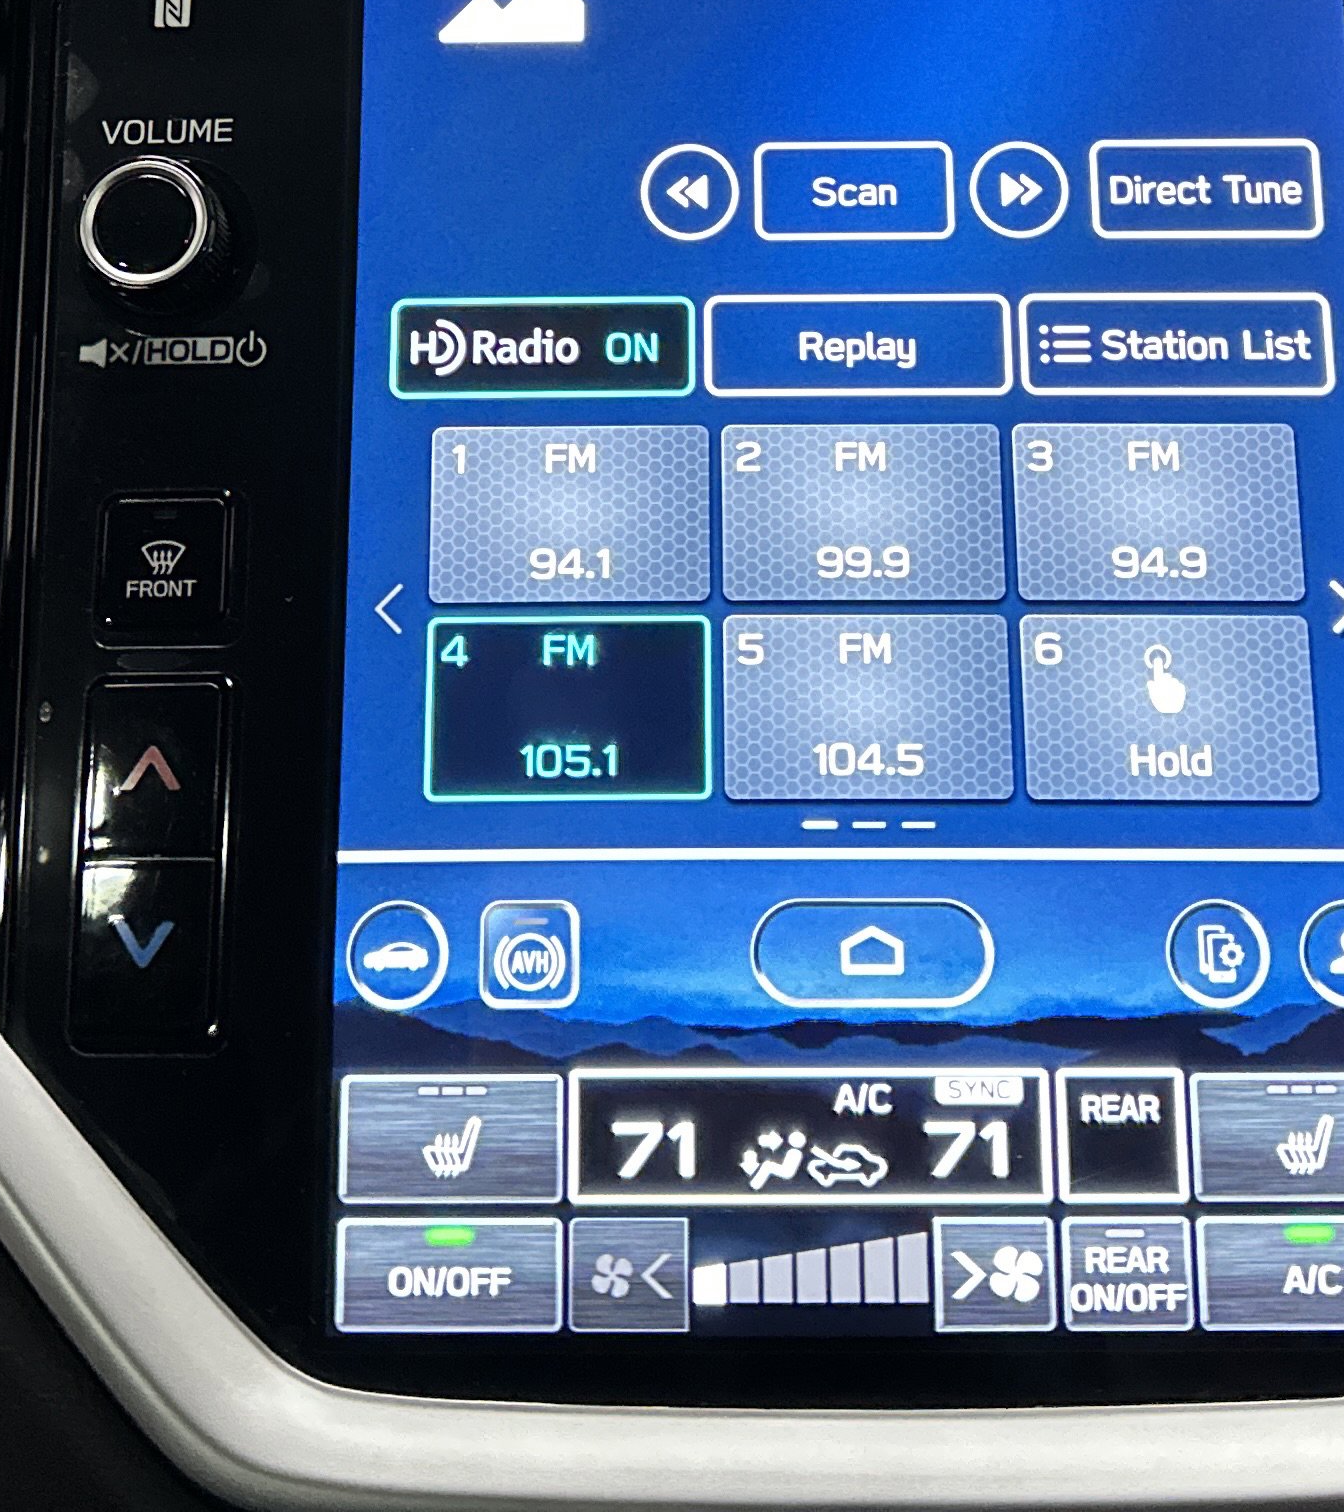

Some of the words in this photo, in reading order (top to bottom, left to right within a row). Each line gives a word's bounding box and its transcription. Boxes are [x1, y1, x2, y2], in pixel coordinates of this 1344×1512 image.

[101, 118, 234, 145] VOLUME
[812, 176, 898, 207] Scan
[1109, 175, 1212, 205] Direct
[1222, 174, 1303, 205] Tune
[148, 339, 232, 363] HOLD
[472, 327, 579, 364] Radio
[605, 332, 658, 364] ON
[799, 331, 917, 369] Replay
[1101, 328, 1229, 361] Station
[1242, 329, 1312, 361] List
[450, 443, 469, 475] 1
[545, 443, 596, 474] FM
[735, 441, 762, 472] 2
[835, 441, 887, 472] FM
[1027, 440, 1054, 472] 3
[1127, 440, 1180, 472] FM
[529, 547, 610, 580] 94.1
[816, 545, 910, 579] 99.9
[1111, 545, 1207, 579] 94.9
[126, 579, 197, 598] FRONT
[440, 635, 469, 667] 4
[542, 632, 596, 667] FM
[737, 632, 764, 666] 5
[839, 632, 892, 665] FM
[1034, 631, 1063, 665] 6
[519, 743, 617, 778] 105.1
[812, 742, 924, 777] 104.5
[1129, 743, 1213, 778] Hold
[507, 946, 552, 975] AVH
[833, 1082, 893, 1115] A/C
[947, 1079, 1012, 1100] SYNC
[1080, 1093, 1161, 1124] REAR
[611, 1119, 696, 1179] 71
[922, 1119, 1009, 1178] 71
[1084, 1244, 1170, 1274] REAR
[387, 1265, 513, 1298] ON/OFF
[1282, 1263, 1344, 1296] A/C
[1068, 1279, 1190, 1315] ON/OFF
